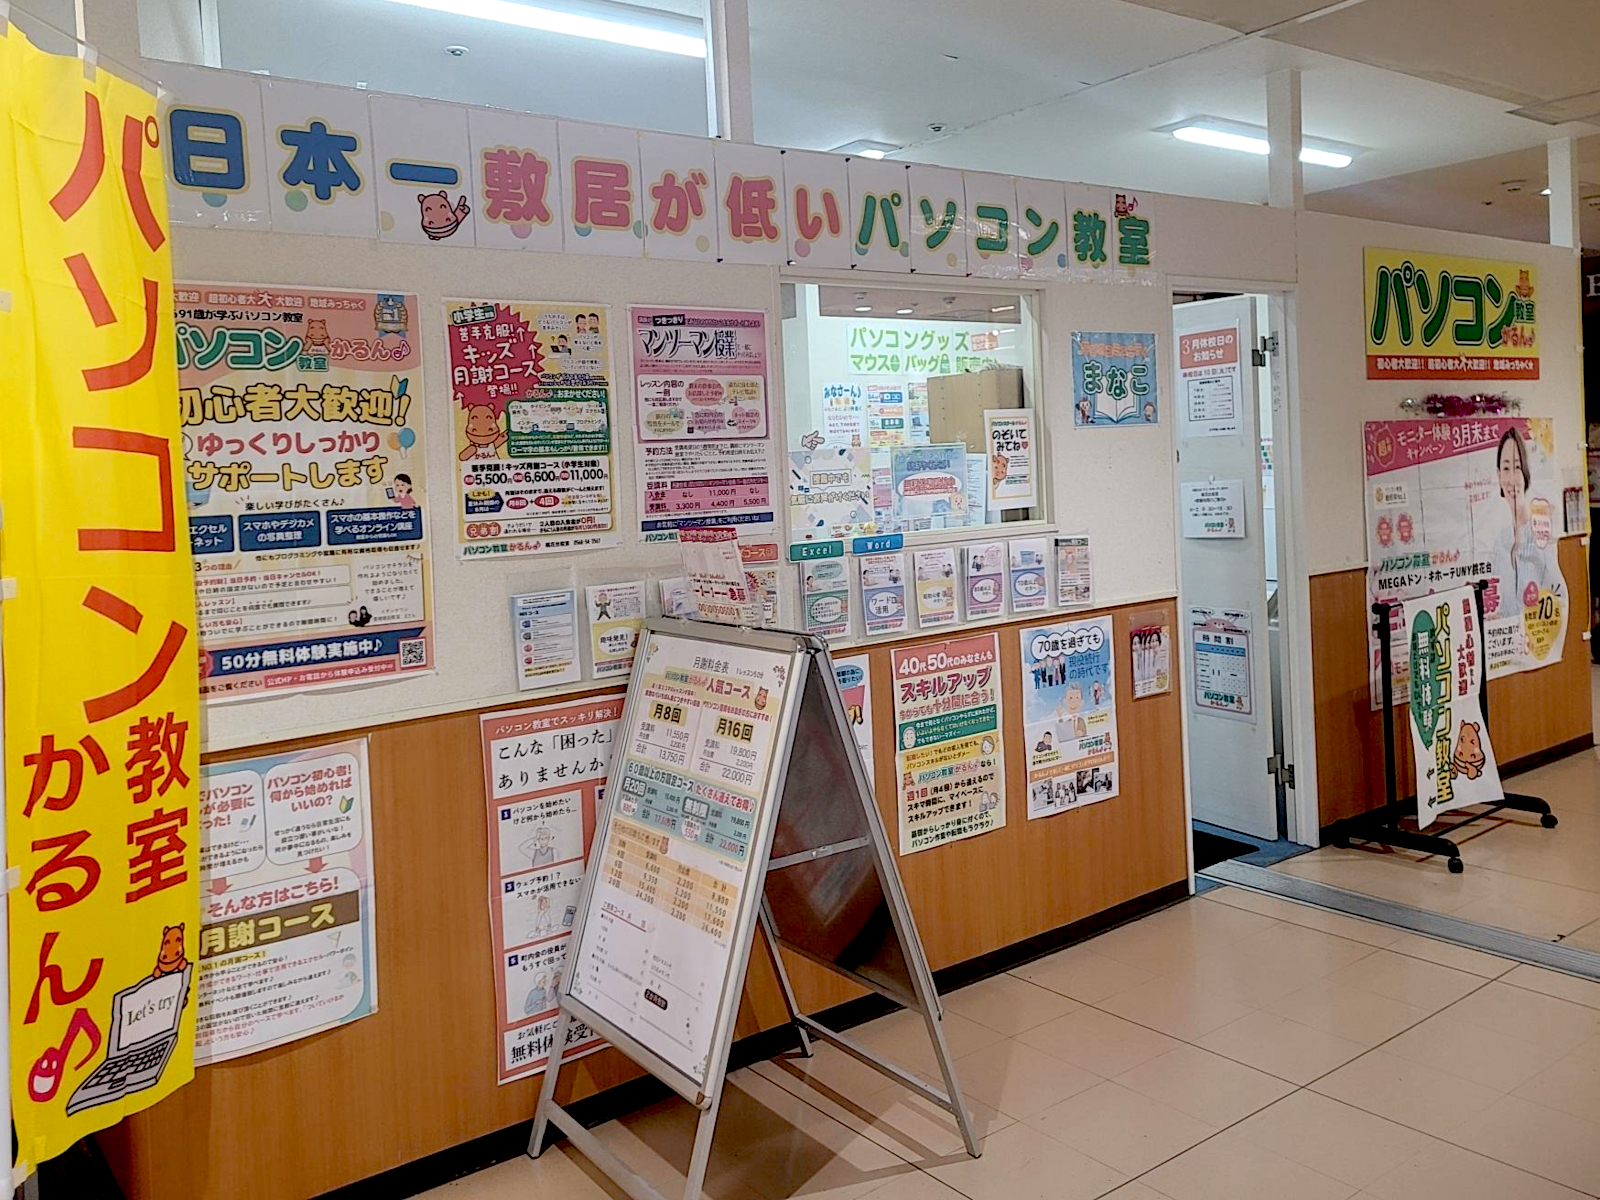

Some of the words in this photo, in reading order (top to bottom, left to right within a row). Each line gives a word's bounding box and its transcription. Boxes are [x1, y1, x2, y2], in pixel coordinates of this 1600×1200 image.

[168, 106, 1151, 266] 日本一敷居が低いパソコン教室
[1371, 261, 1520, 348] パソコン
[1514, 299, 1536, 323] 教室
[459, 324, 515, 342] 苦手克服!
[852, 328, 969, 351] パソコングッズ
[330, 339, 391, 360] かるん
[463, 339, 514, 364] キッズ
[1182, 335, 1234, 355] 3月休校日の
[1193, 349, 1224, 362] お知らせ
[297, 354, 329, 371] 教室
[454, 360, 539, 386] 月謝コース
[851, 354, 893, 373] マウス
[905, 353, 940, 372] バッグ
[487, 383, 518, 398] 登場!!
[640, 379, 684, 388] レッスン内容の
[1082, 360, 1149, 400] まなこ
[196, 431, 380, 457] ゆっくりしっかり
[1397, 424, 1450, 446] モニター体験
[1452, 421, 1499, 447] 3月末まで
[997, 441, 1021, 452] みてね
[1407, 444, 1445, 461] キャンペーン
[187, 455, 388, 492] サポートします
[475, 473, 512, 487] 5,500円
[524, 470, 560, 484] 6,600円
[570, 468, 608, 482] 11,000円
[50, 91, 190, 904] パソコン教室
[245, 498, 341, 511] 楽しい学びがたくさん
[676, 502, 701, 510] 3,300円
[711, 500, 735, 508] 4,400円
[743, 498, 767, 506] 5,500円
[683, 490, 693, 498] なし
[243, 519, 314, 531] スマホやデジカメ
[334, 522, 413, 535] 学べるオンライン講座
[802, 545, 833, 557] Excel
[866, 540, 892, 550] Word
[1379, 562, 1492, 590] MEGAドン・キホーテUNY桃花台
[875, 605, 889, 614] 活用
[600, 633, 628, 644] 趣味発見!
[1038, 633, 1100, 652] 70歳を過ぎても
[221, 640, 374, 670] 50分無料体験実施中
[693, 657, 730, 675] 月謝料金表
[899, 650, 993, 675] 40代50代のみなさんも
[1068, 651, 1105, 667] 現役続行
[1068, 663, 1108, 680] の時代です
[1417, 631, 1434, 732] 無料体験
[706, 678, 751, 699] 人気コース
[900, 665, 992, 704] スキルアップ
[653, 703, 682, 724] 月8回
[900, 687, 995, 721] 今からでも十分間に合う!
[1434, 602, 1454, 805] パソコン教室
[495, 707, 618, 735] パソコン教室でスッキリ解決!
[716, 718, 754, 742] 月16回
[499, 728, 614, 760] こんな「困った」
[666, 728, 689, 742] 11,550円
[635, 743, 648, 754] 合計
[659, 749, 685, 765] 13,750円
[730, 745, 757, 761] 19,800円
[267, 765, 352, 789] パソコン初心者!
[498, 757, 604, 790] ありませんか
[700, 761, 711, 773] 合計
[721, 767, 753, 786] 22,000円
[270, 777, 352, 803] 何から始めれば
[624, 777, 646, 796] 月20回
[291, 795, 333, 812] いいの?
[513, 797, 572, 815] パソコンを始めたい
[907, 785, 984, 812] スキマ時間に、マイペースに
[908, 801, 972, 823] スキルアップできます!
[22, 733, 110, 1026] かるん
[516, 877, 581, 899] スマホが活用できない
[207, 876, 339, 918] そんな方はこちら!
[705, 901, 726, 918] 11,550
[201, 902, 336, 956] 月謝コース
[127, 999, 156, 1026] Let's
[158, 995, 176, 1010] try
